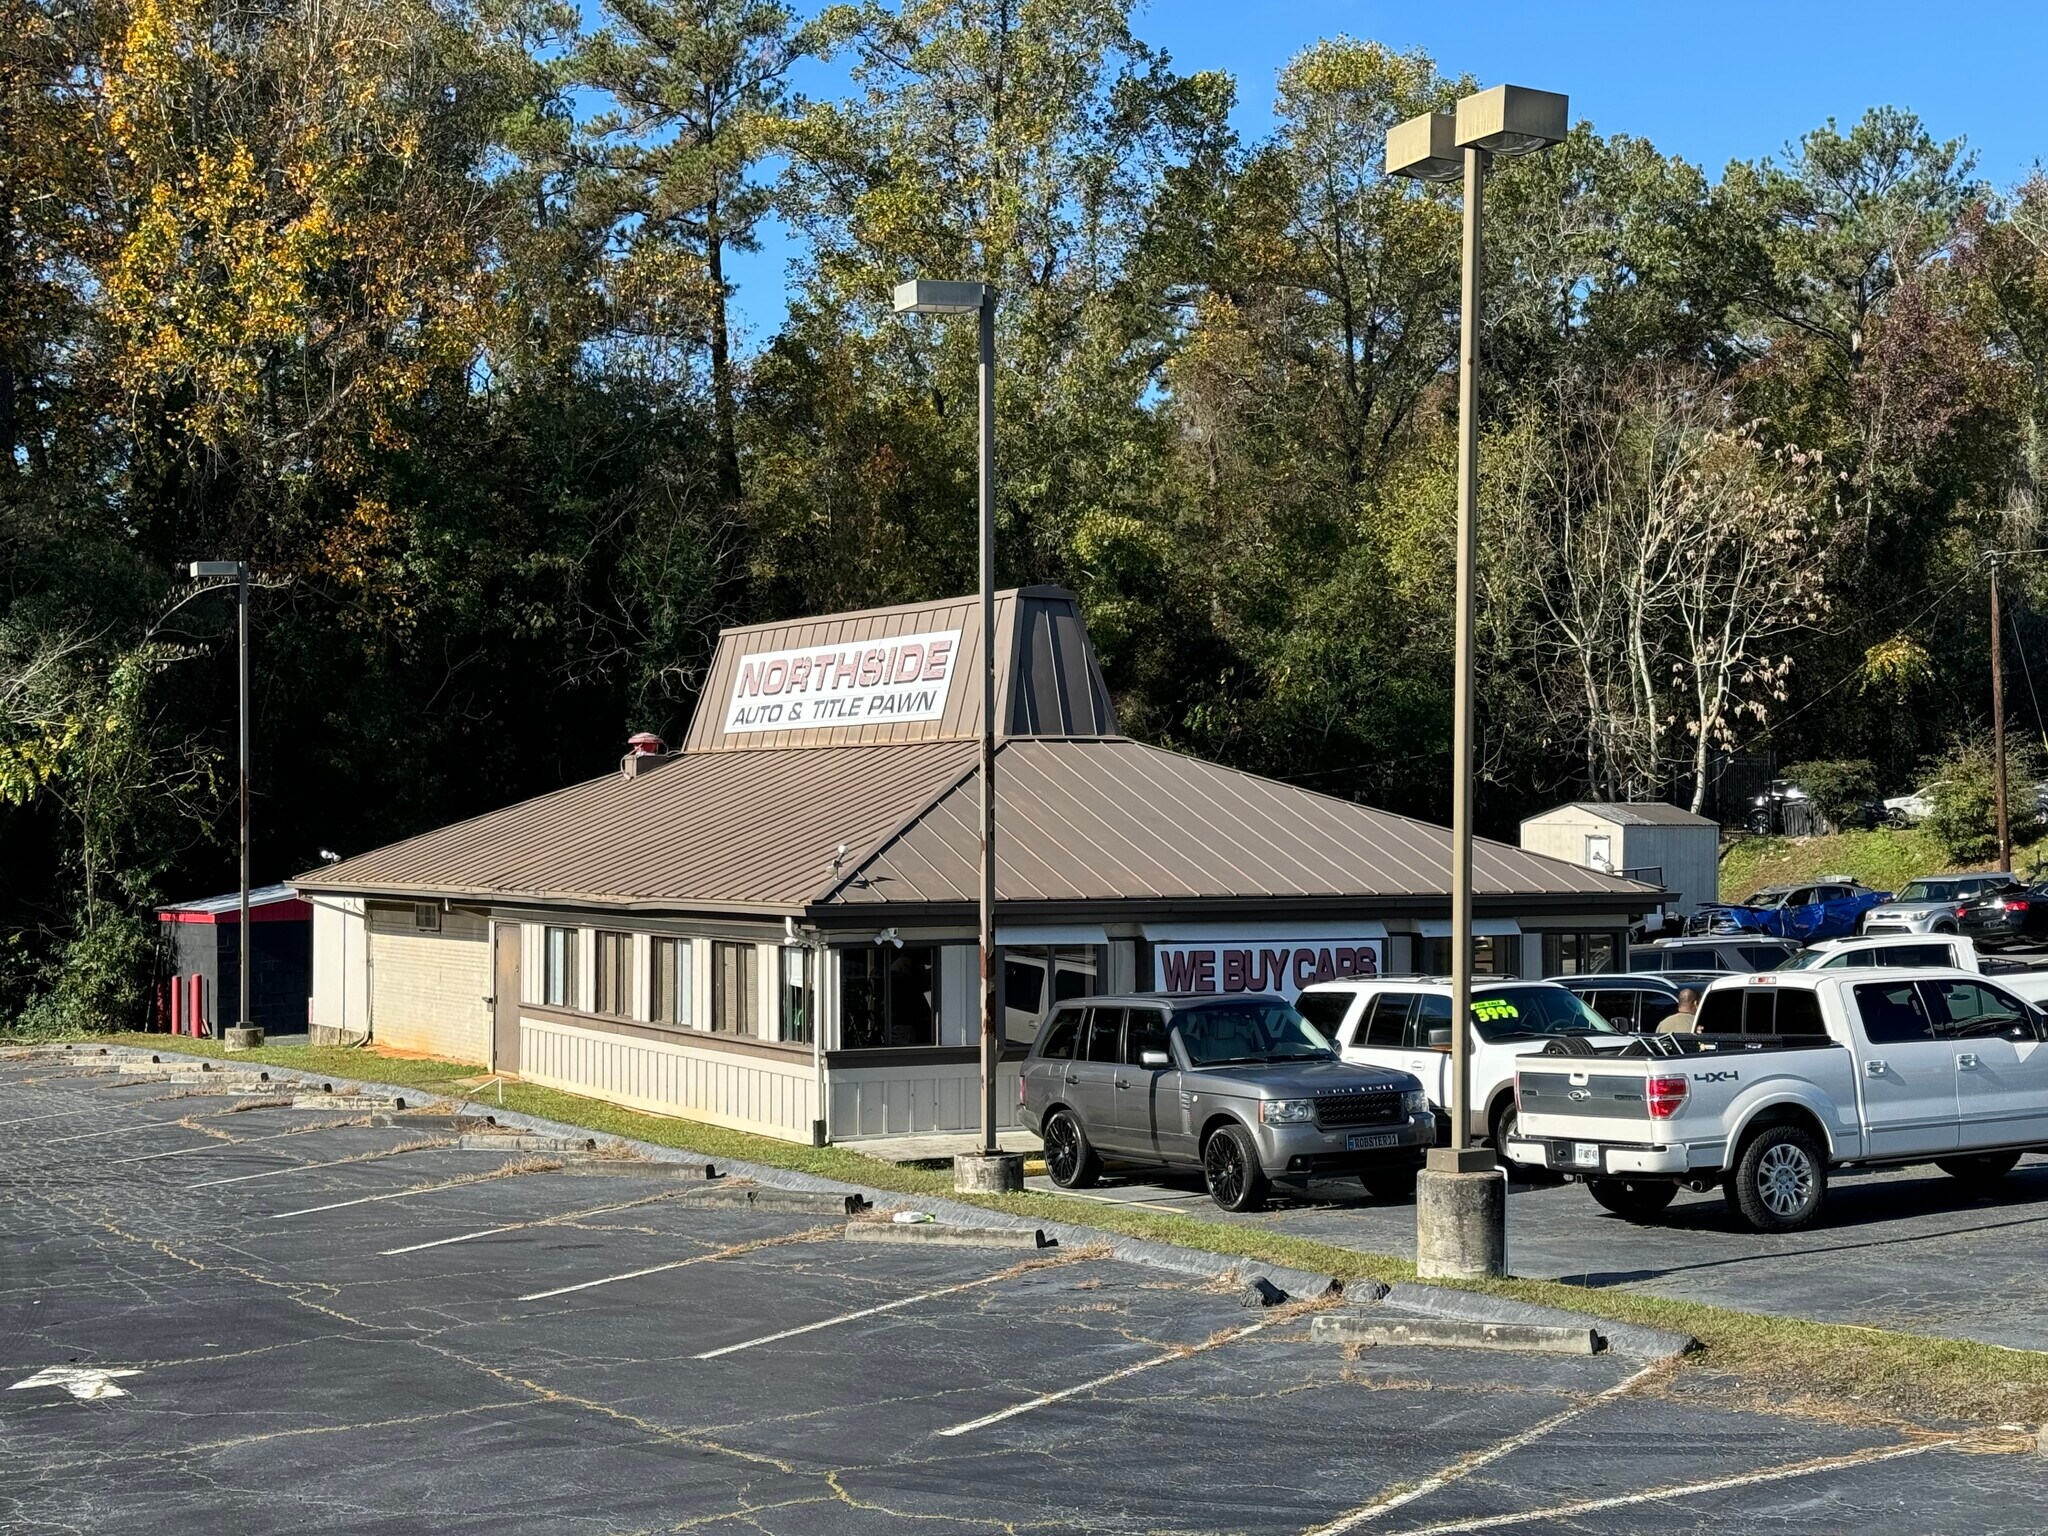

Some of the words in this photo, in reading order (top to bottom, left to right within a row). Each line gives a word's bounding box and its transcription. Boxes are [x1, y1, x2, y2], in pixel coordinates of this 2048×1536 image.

[737, 640, 953, 697] NORTHSIDE
[732, 704, 784, 726] AUTO
[788, 702, 803, 722] &
[813, 697, 864, 719] TITLE
[867, 690, 937, 716] PAWN
[1161, 950, 1216, 992] WE
[1223, 949, 1291, 992] BUY
[1475, 1005, 1519, 1022] 3999
[1694, 1071, 1739, 1083] 4X4
[1354, 1134, 1397, 1149] ROBSTER11
